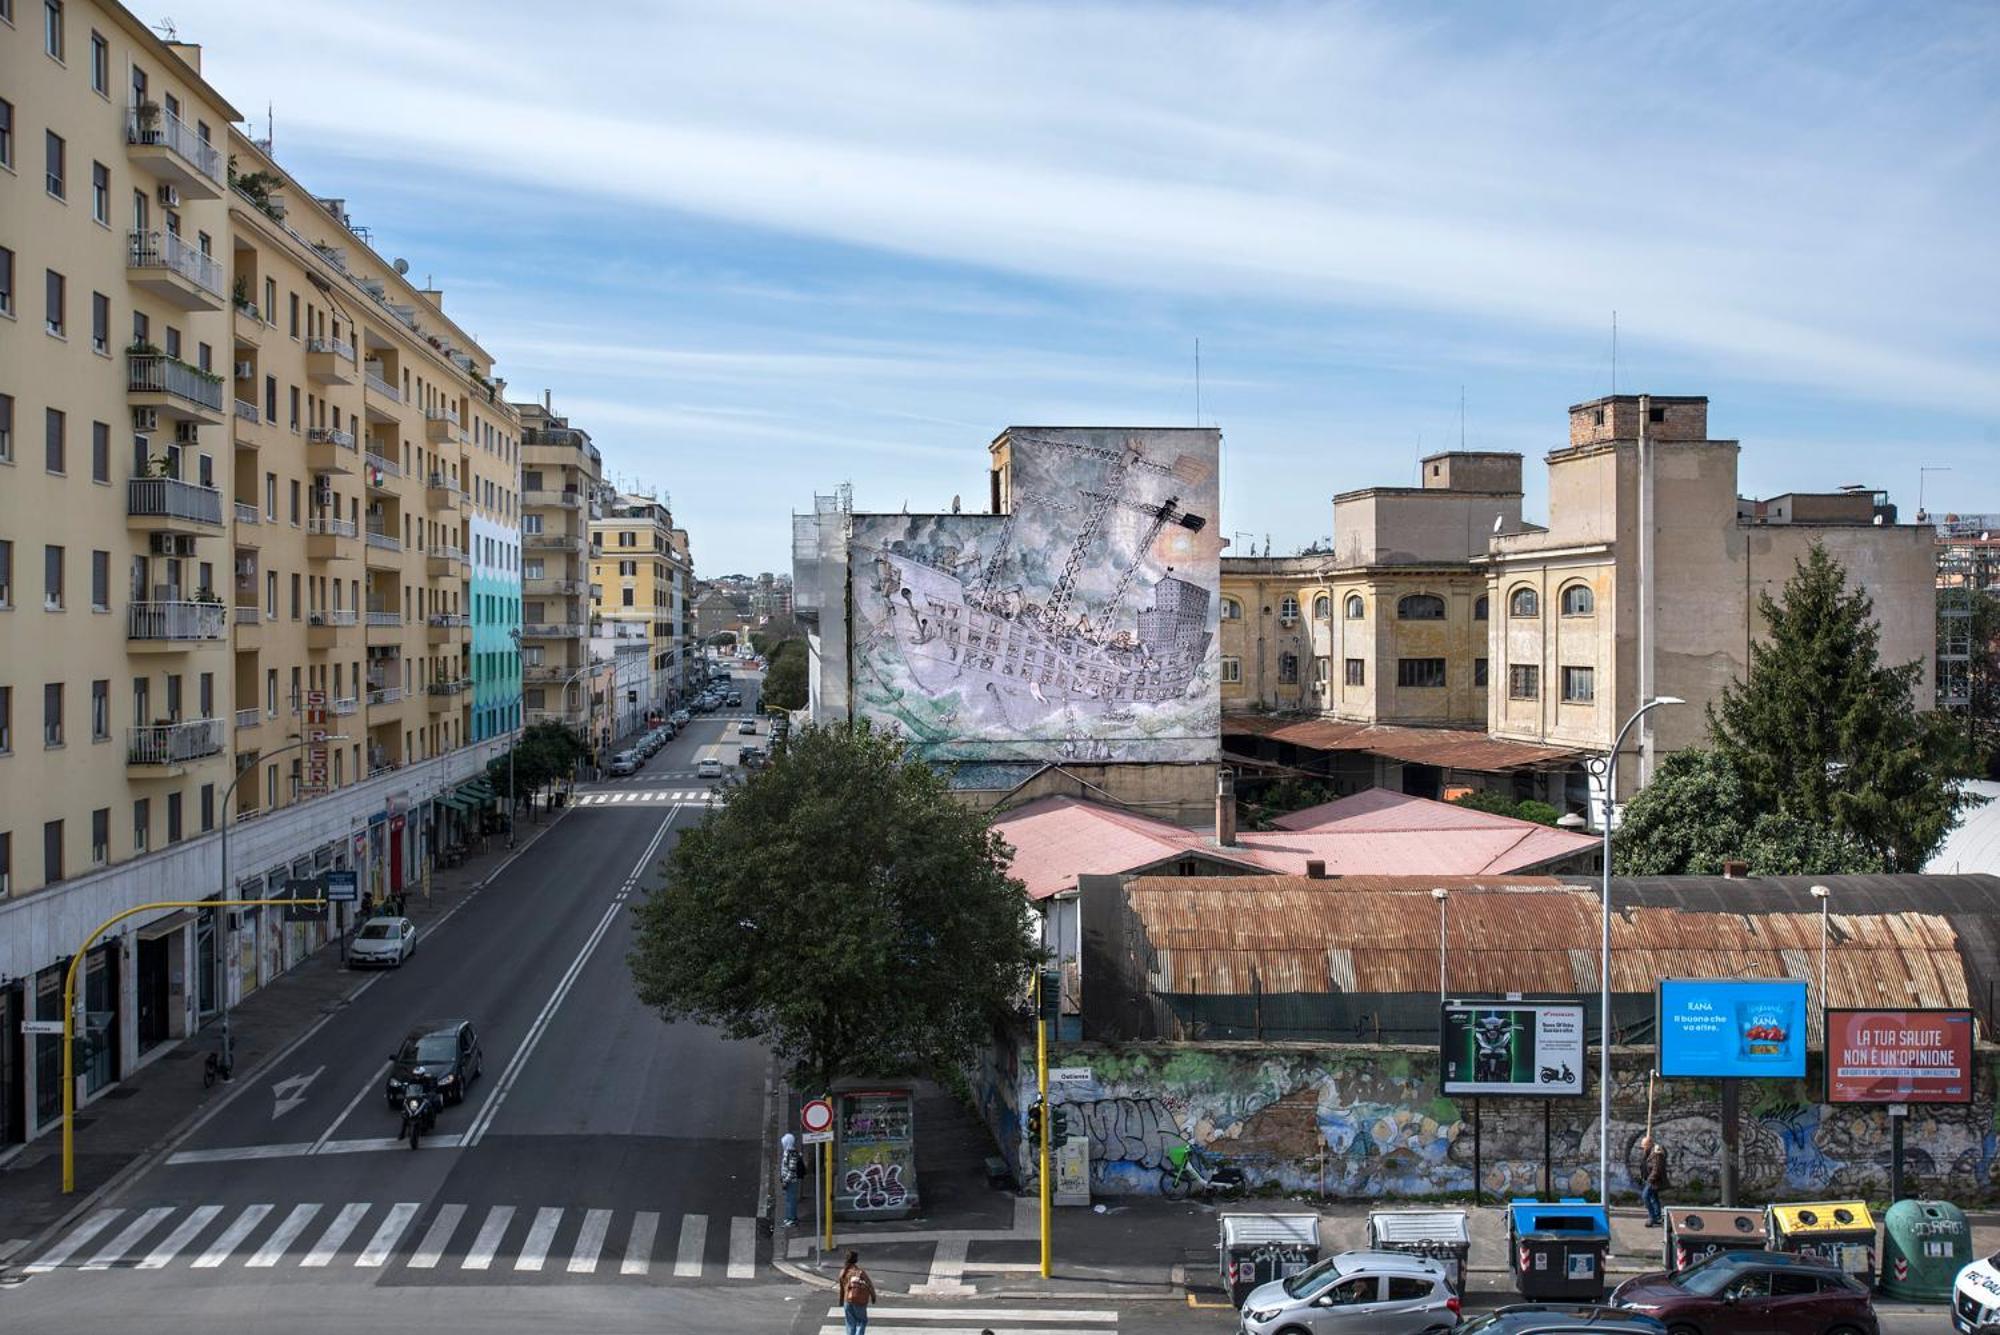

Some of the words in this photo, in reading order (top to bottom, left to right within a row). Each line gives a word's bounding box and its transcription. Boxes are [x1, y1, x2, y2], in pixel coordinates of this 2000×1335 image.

[1856, 1030, 1870, 1046] LA
[1874, 1030, 1896, 1046] TUA
[1899, 1030, 1942, 1046] SALUTE
[1844, 1049, 1868, 1066] NON
[1880, 1049, 1955, 1066] UN'OPINIONE
